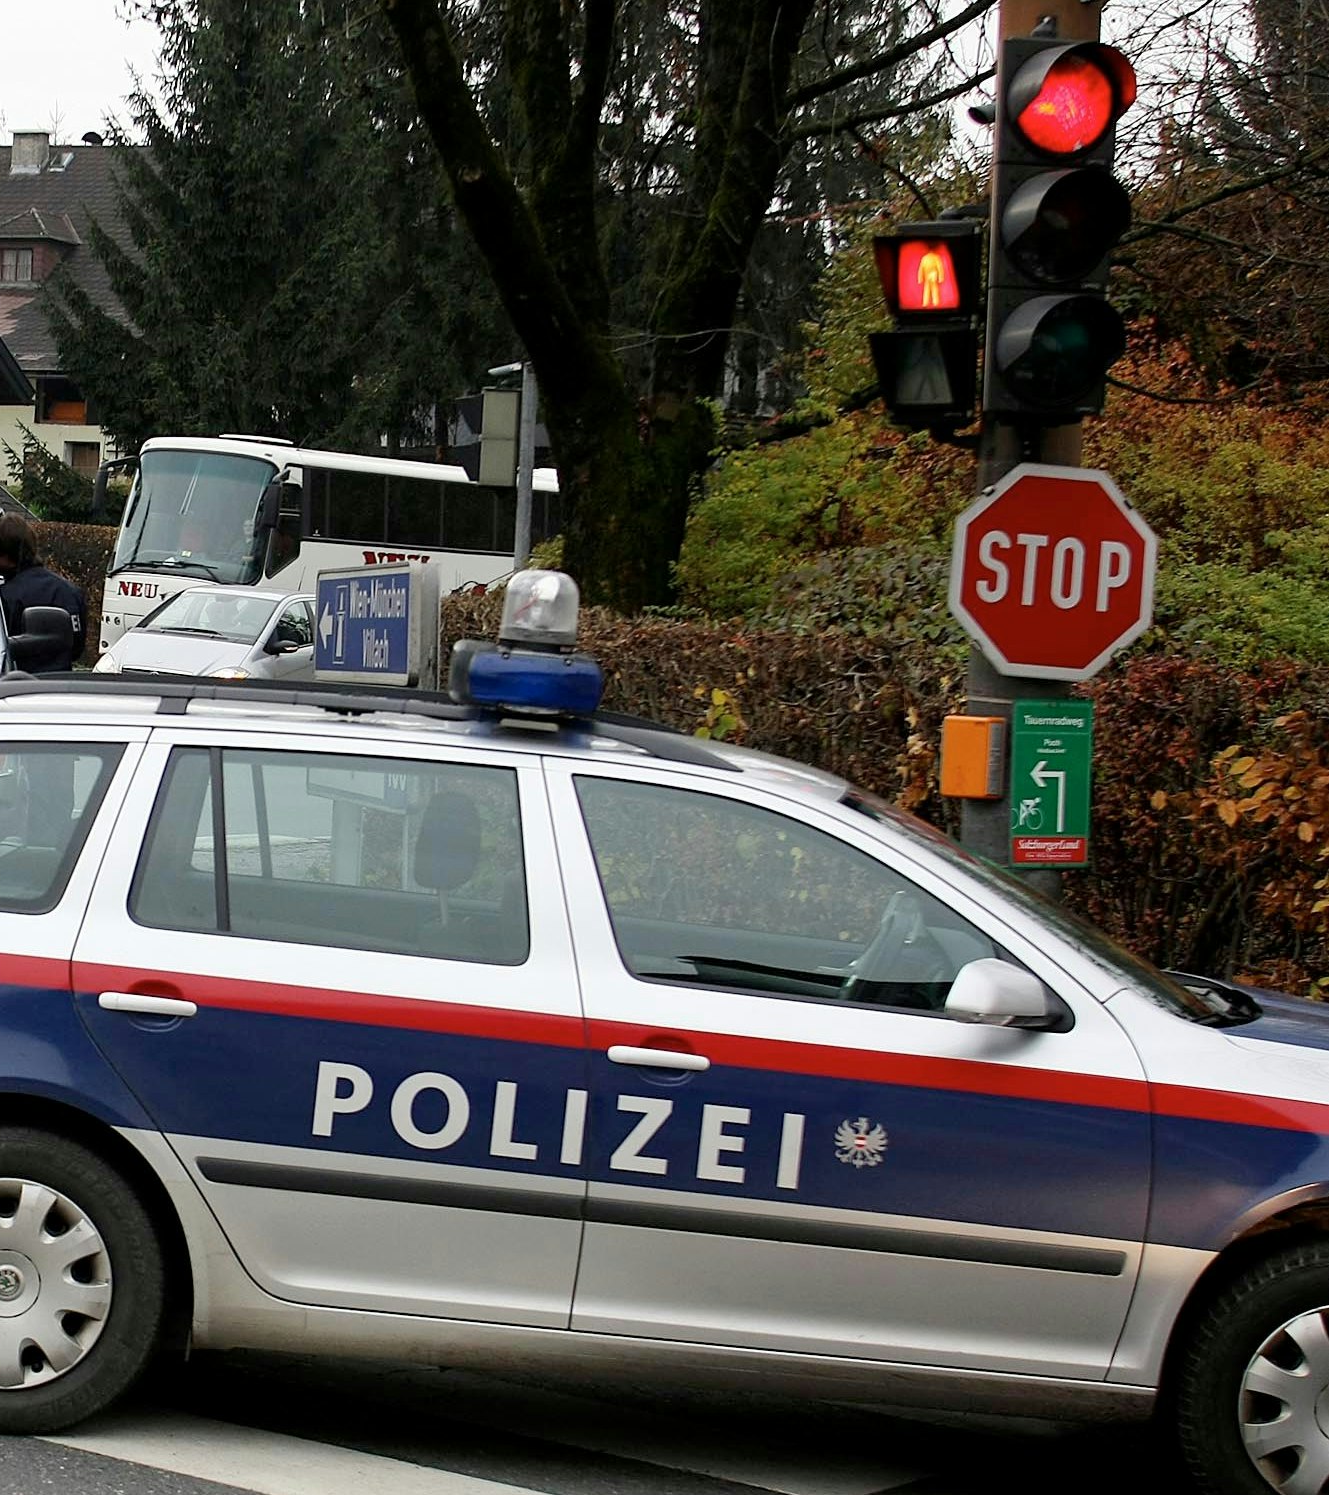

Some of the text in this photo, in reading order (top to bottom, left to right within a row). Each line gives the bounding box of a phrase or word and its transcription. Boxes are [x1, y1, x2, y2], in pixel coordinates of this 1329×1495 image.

[117, 580, 159, 599] NEU
[975, 530, 1131, 612] STOP
[362, 628, 389, 668] Villach
[311, 1060, 806, 1190] POLIZEI
